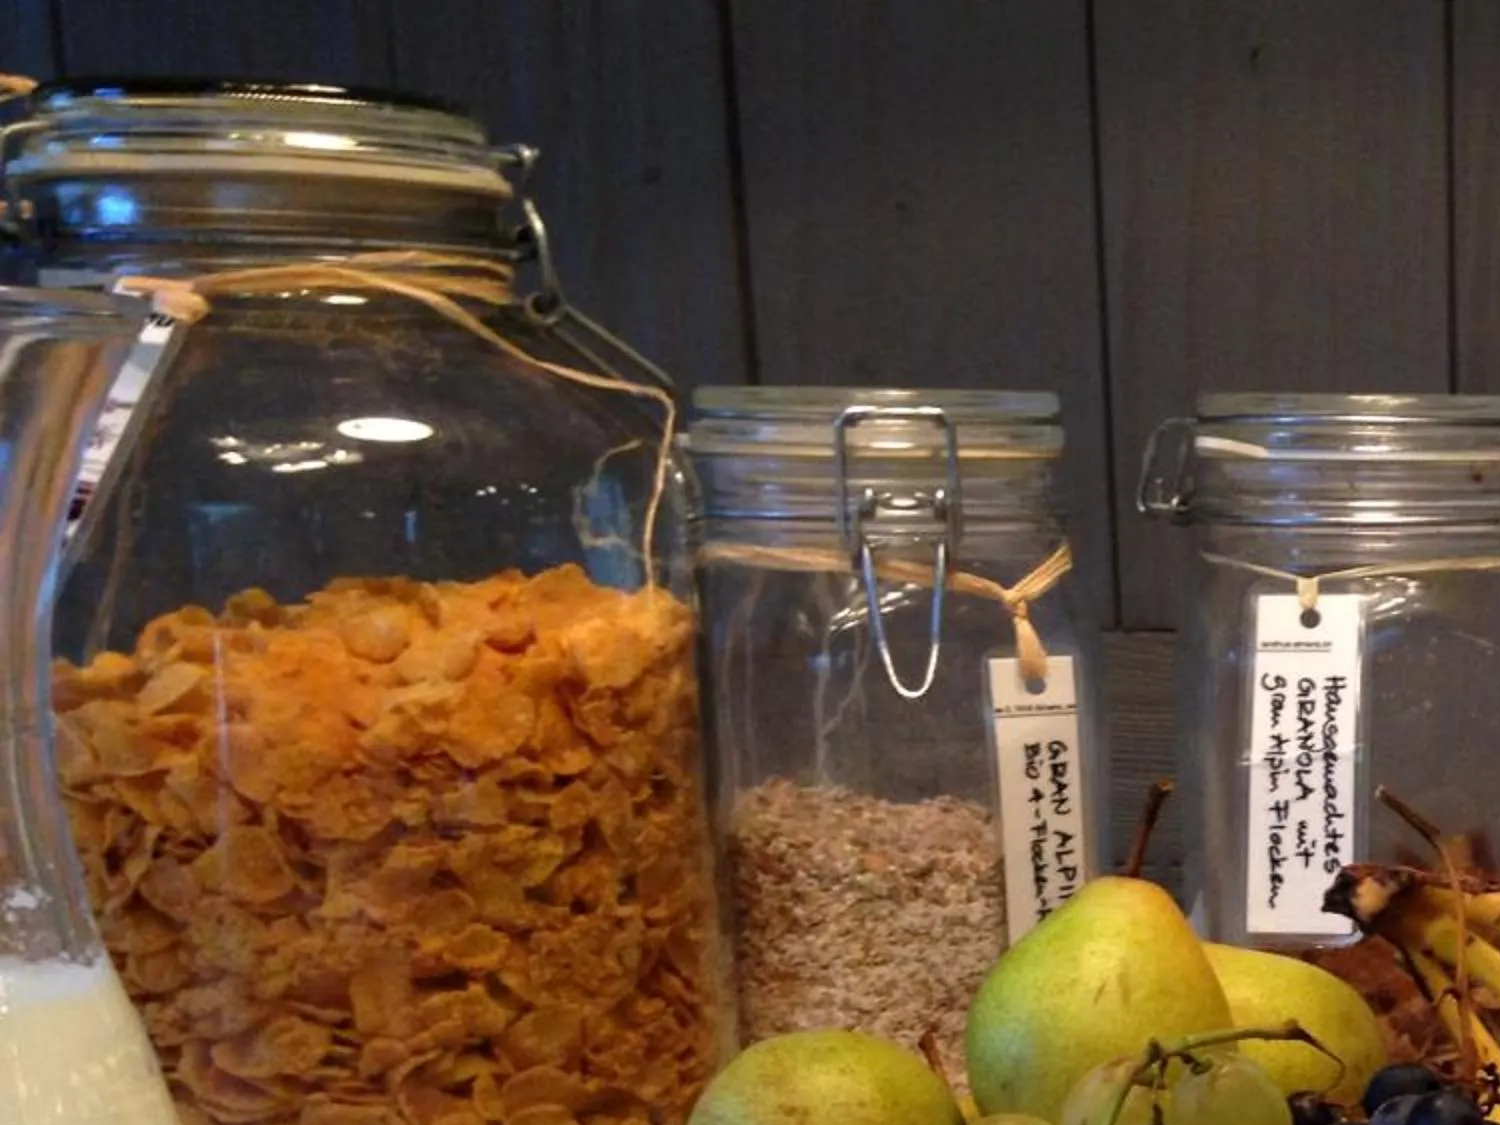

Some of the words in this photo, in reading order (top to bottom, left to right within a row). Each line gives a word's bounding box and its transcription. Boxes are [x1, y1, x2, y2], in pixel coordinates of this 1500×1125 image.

[1024, 742, 1043, 780] Bio
[1295, 677, 1316, 802] GRANOLA
[1047, 740, 1071, 815] GRAN
[1267, 799, 1289, 909] Flocken
[1295, 820, 1316, 869] mit
